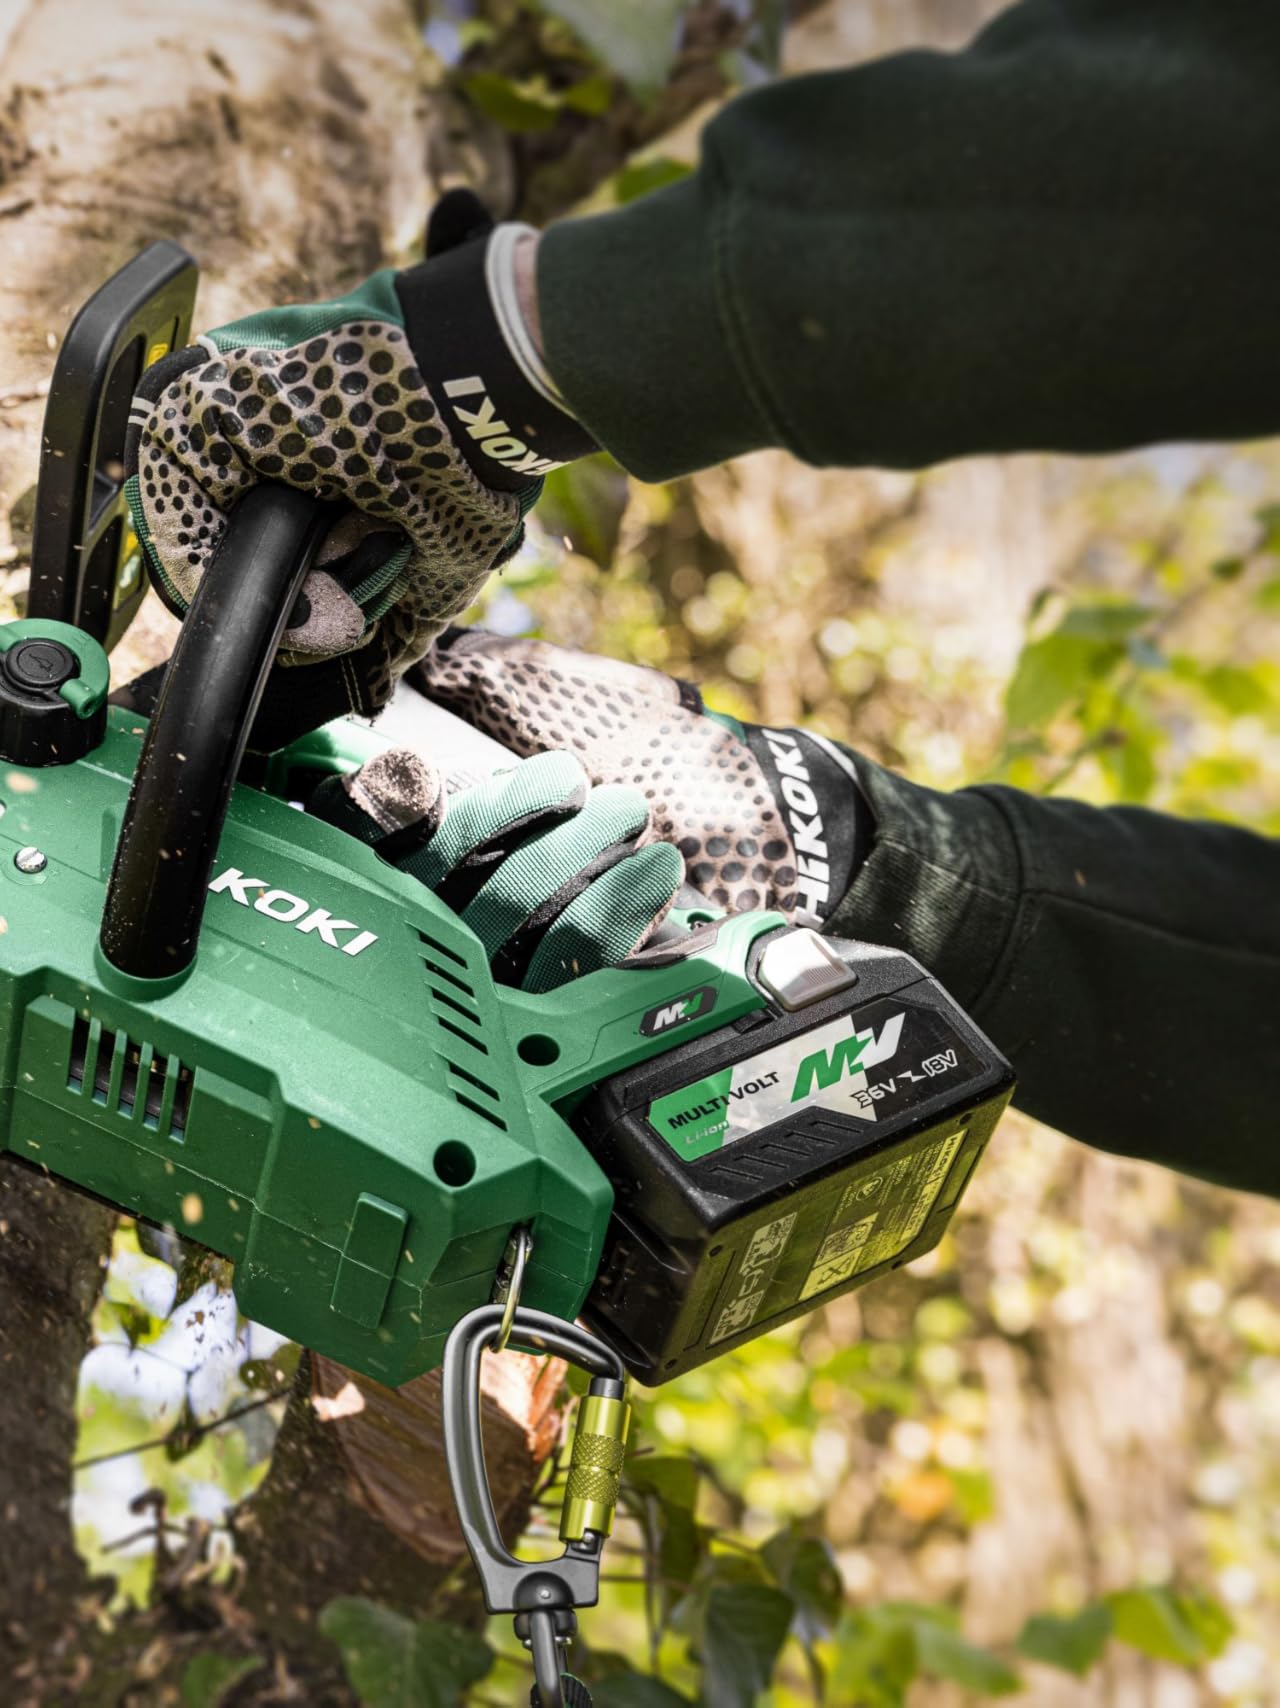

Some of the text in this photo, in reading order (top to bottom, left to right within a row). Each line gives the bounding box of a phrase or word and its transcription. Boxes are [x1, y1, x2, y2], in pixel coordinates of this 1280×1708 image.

[207, 867, 379, 958] KOKI
[666, 1071, 781, 1130] MULTI VOLT
[849, 1049, 959, 1110] 36V 18V
[685, 1119, 730, 1144] Li-ion
